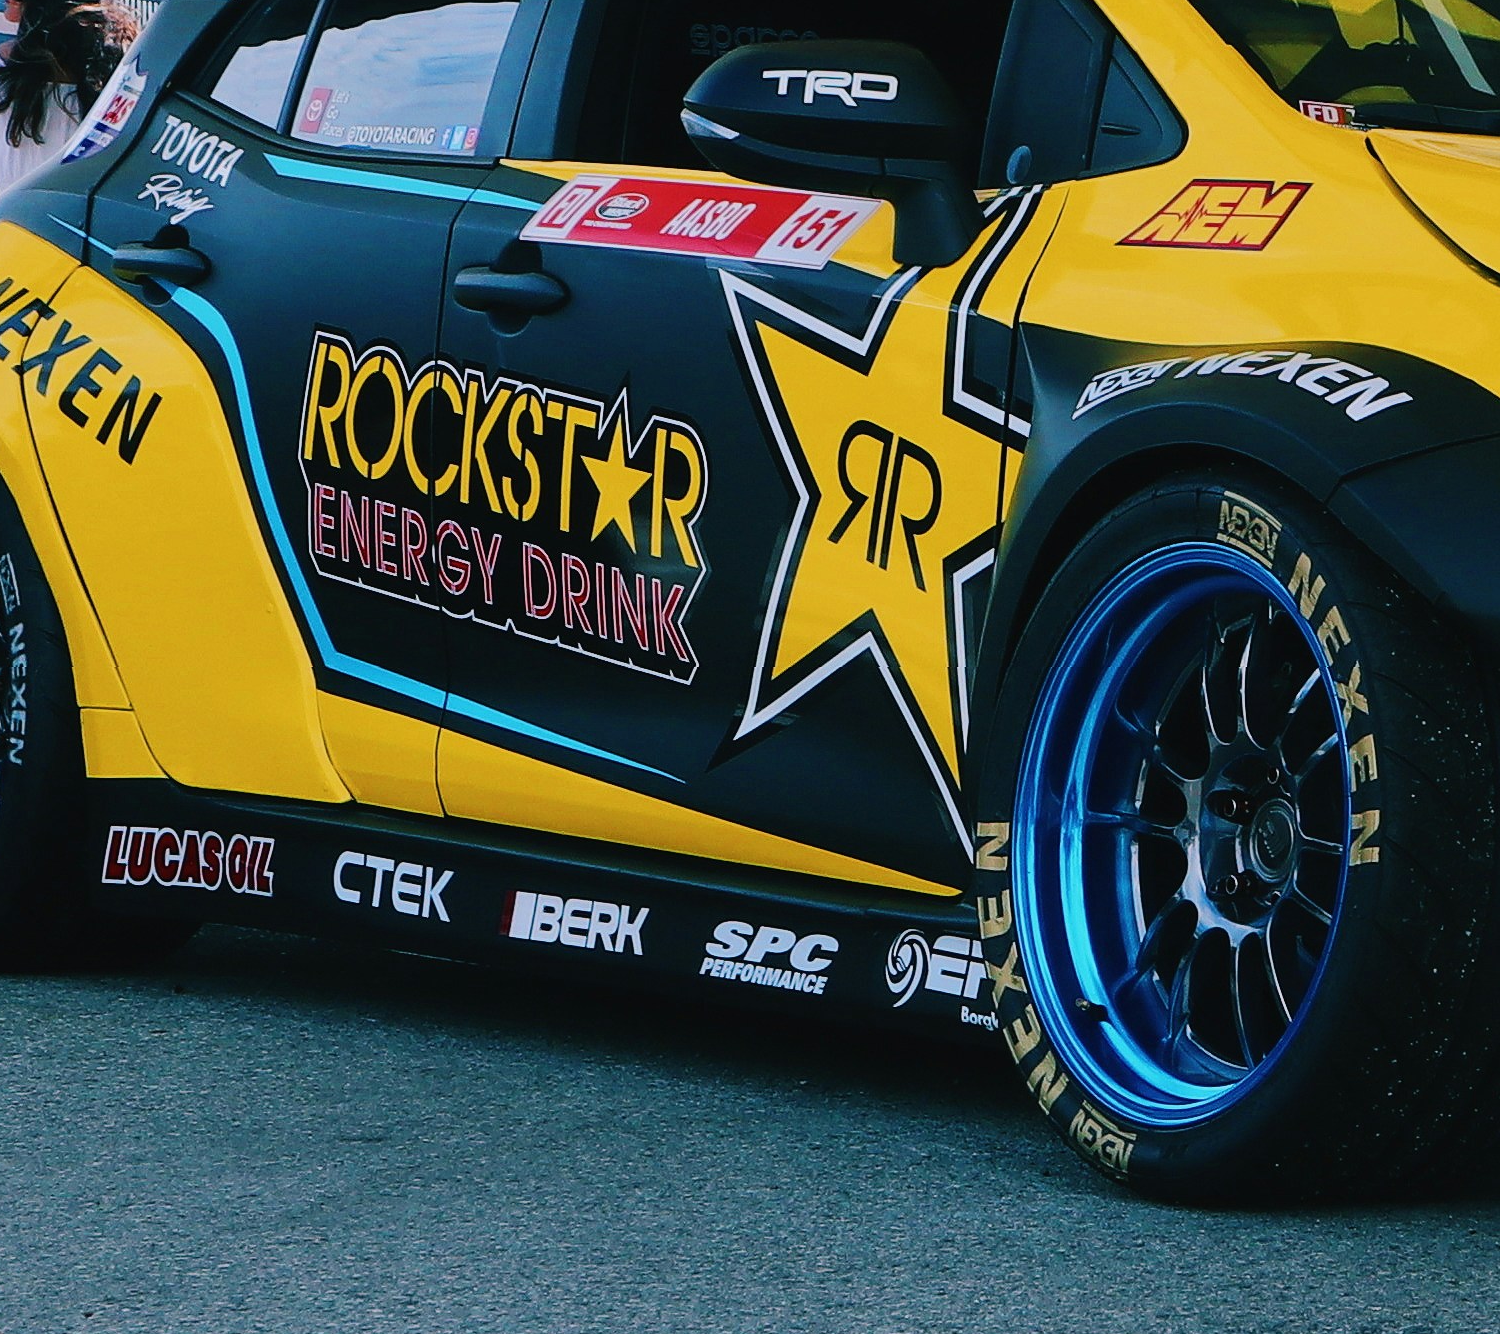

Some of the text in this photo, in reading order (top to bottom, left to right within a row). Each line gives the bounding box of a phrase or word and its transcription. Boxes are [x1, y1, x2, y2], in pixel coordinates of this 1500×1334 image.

[762, 69, 899, 107] TRD
[1308, 104, 1339, 123] FD
[151, 114, 244, 187] TOYOTA
[348, 125, 436, 146] @TOYOTARACING
[659, 198, 758, 241] AASBO
[780, 205, 859, 252] 151
[1173, 350, 1414, 422] NEXEN
[313, 482, 688, 663] ENERGY DRINK
[6, 622, 31, 767] NEXEN
[1288, 552, 1381, 867] NEXEN
[102, 825, 276, 897] LUCAS OIL
[332, 850, 455, 923] CTEK
[529, 896, 650, 956] BERK
[705, 920, 840, 972] SPC
[699, 957, 830, 995] PERFORMANCE
[924, 934, 988, 999] EF
[975, 821, 1069, 1116] NEXEN
